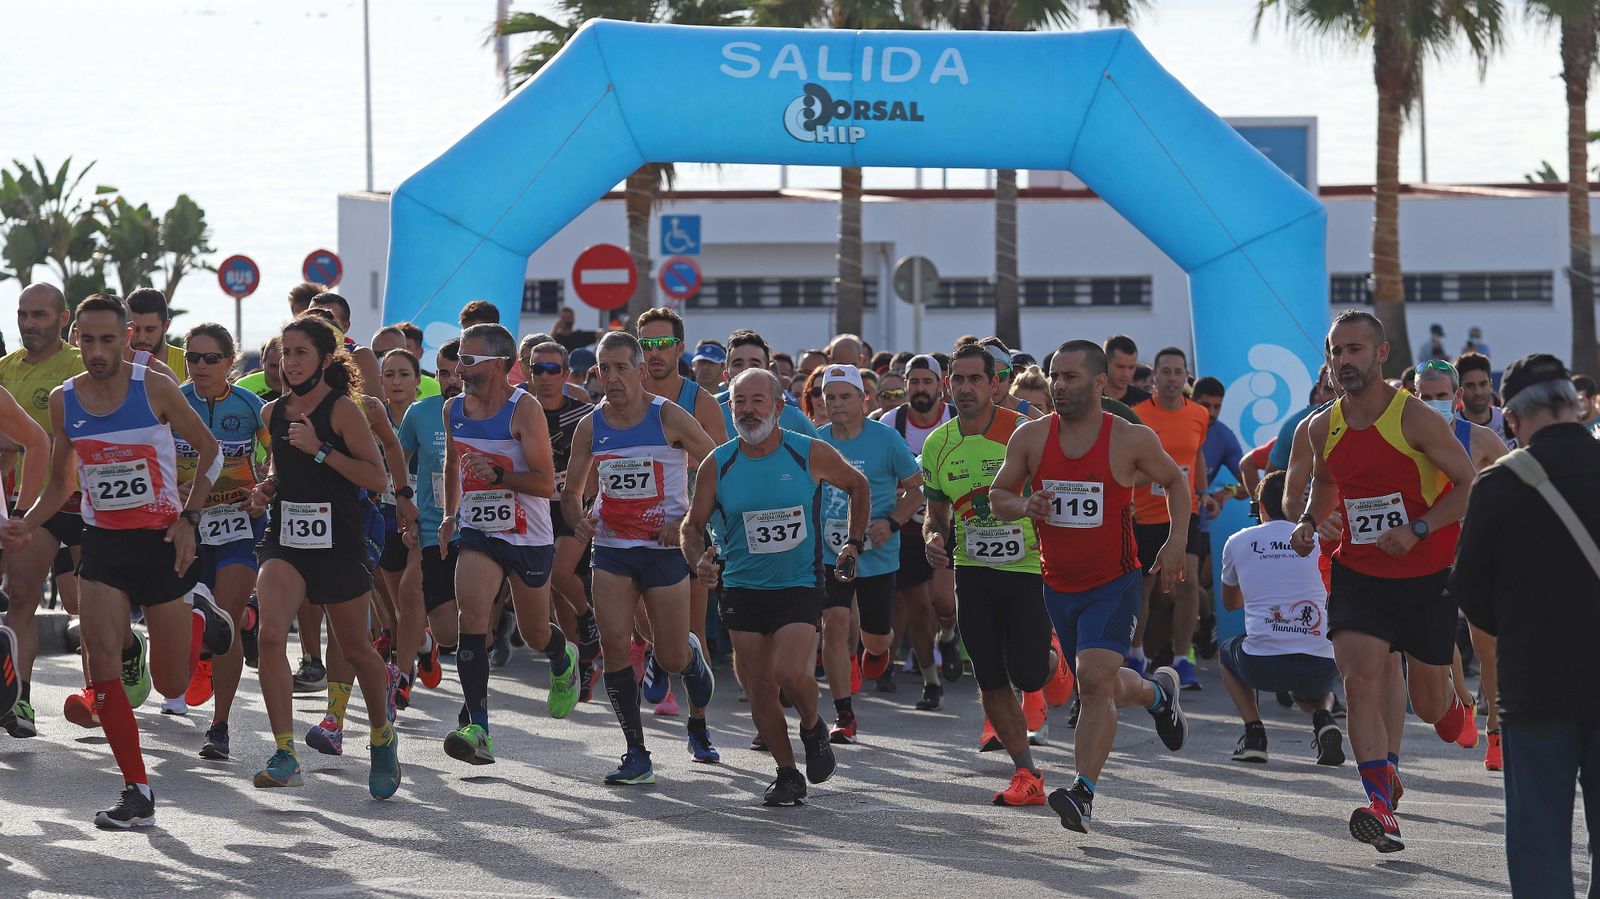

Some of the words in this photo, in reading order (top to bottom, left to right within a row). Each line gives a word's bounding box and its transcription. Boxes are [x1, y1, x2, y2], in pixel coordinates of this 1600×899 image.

[720, 41, 969, 86] SALIDA
[803, 83, 925, 125] DORSAL
[783, 95, 866, 144] CHIP
[226, 269, 254, 286] BUS
[98, 477, 148, 499] 226
[609, 473, 650, 490] 257
[471, 505, 511, 522] 256
[1051, 498, 1098, 517] 119
[207, 517, 247, 537] 212
[288, 519, 327, 537] 130
[1355, 511, 1404, 533] 278
[756, 522, 801, 543] 337
[975, 541, 1020, 558] 229
[1251, 541, 1265, 554] L.
[1271, 623, 1308, 635] Running
